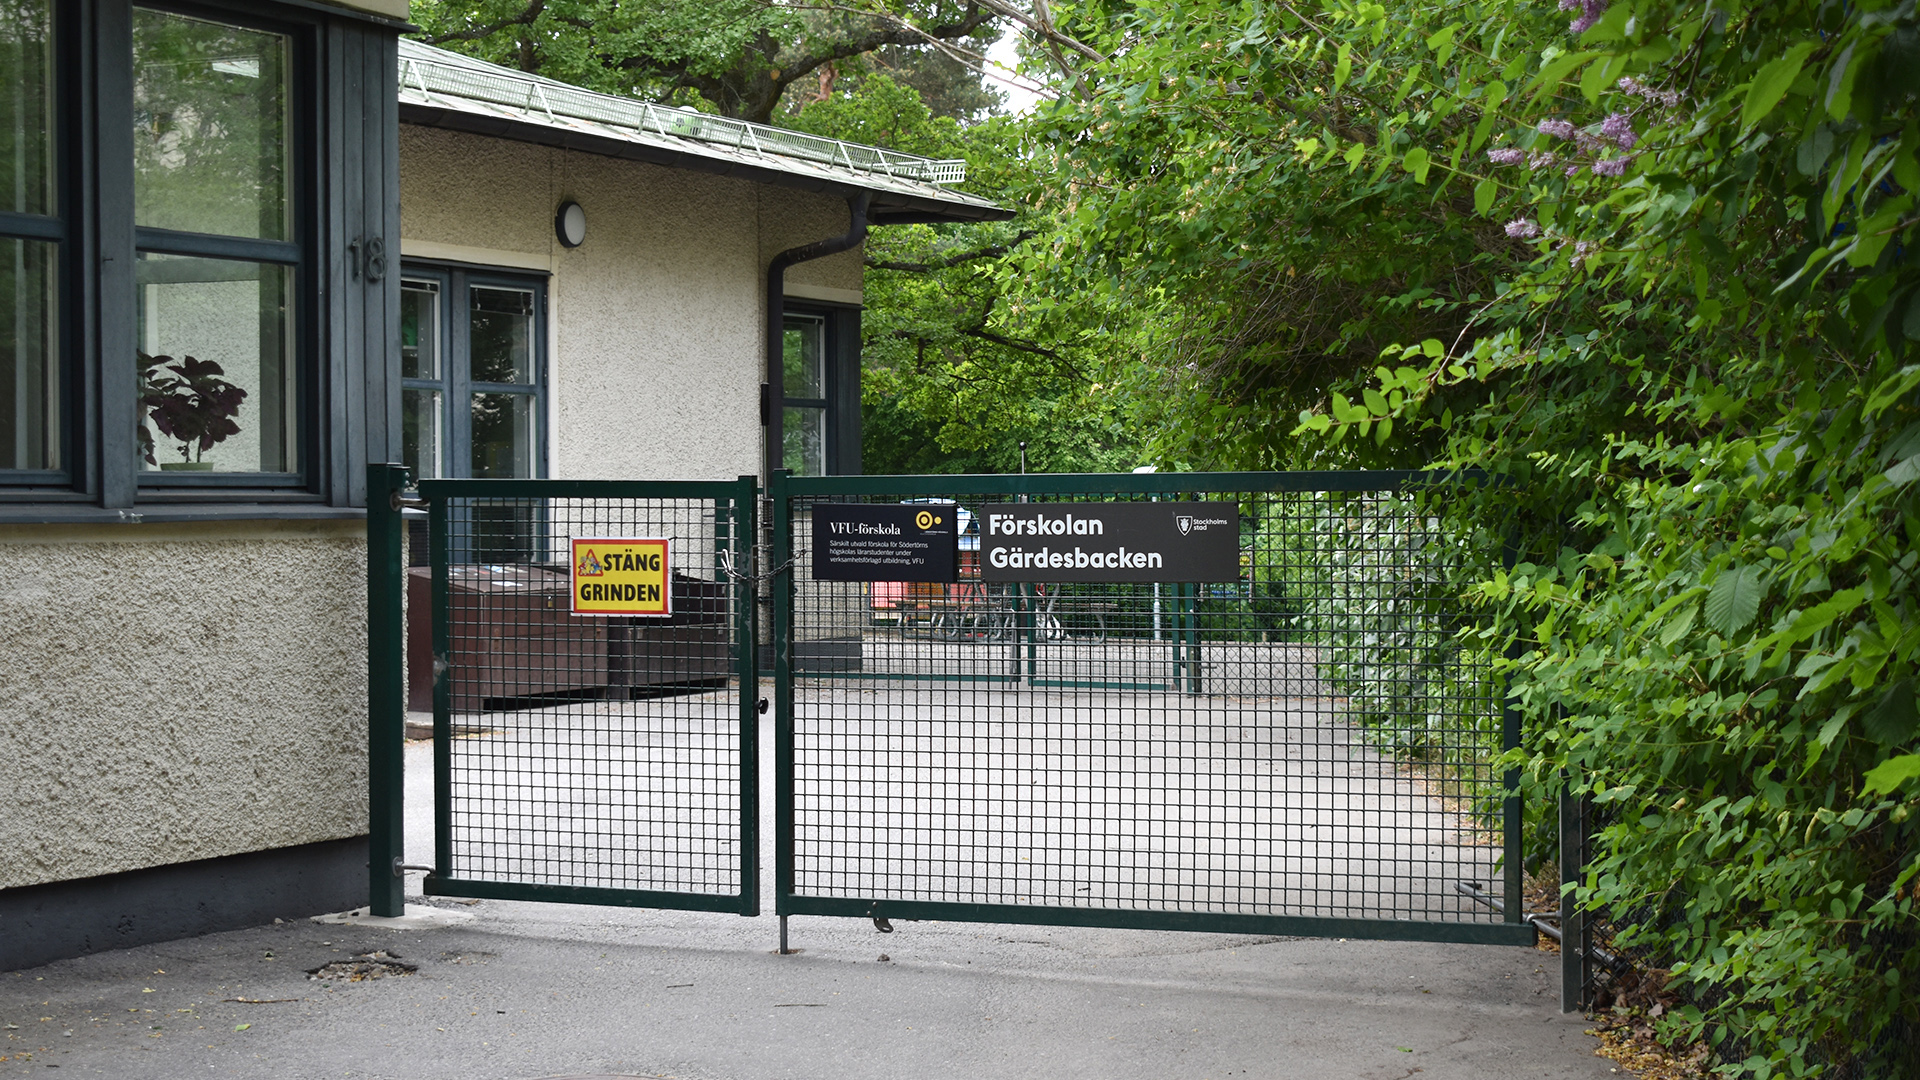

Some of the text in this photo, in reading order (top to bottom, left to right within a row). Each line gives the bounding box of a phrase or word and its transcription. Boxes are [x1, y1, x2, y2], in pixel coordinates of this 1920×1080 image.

[350, 236, 388, 280] 18
[830, 522, 901, 535] VFU-förskola
[989, 513, 1103, 536] Förskolan
[830, 548, 856, 556] högskolas
[867, 540, 889, 548] förskola
[604, 549, 660, 571] STÄNG
[989, 546, 1163, 569] Gärdesbacken
[581, 584, 660, 601] GRINDEN
